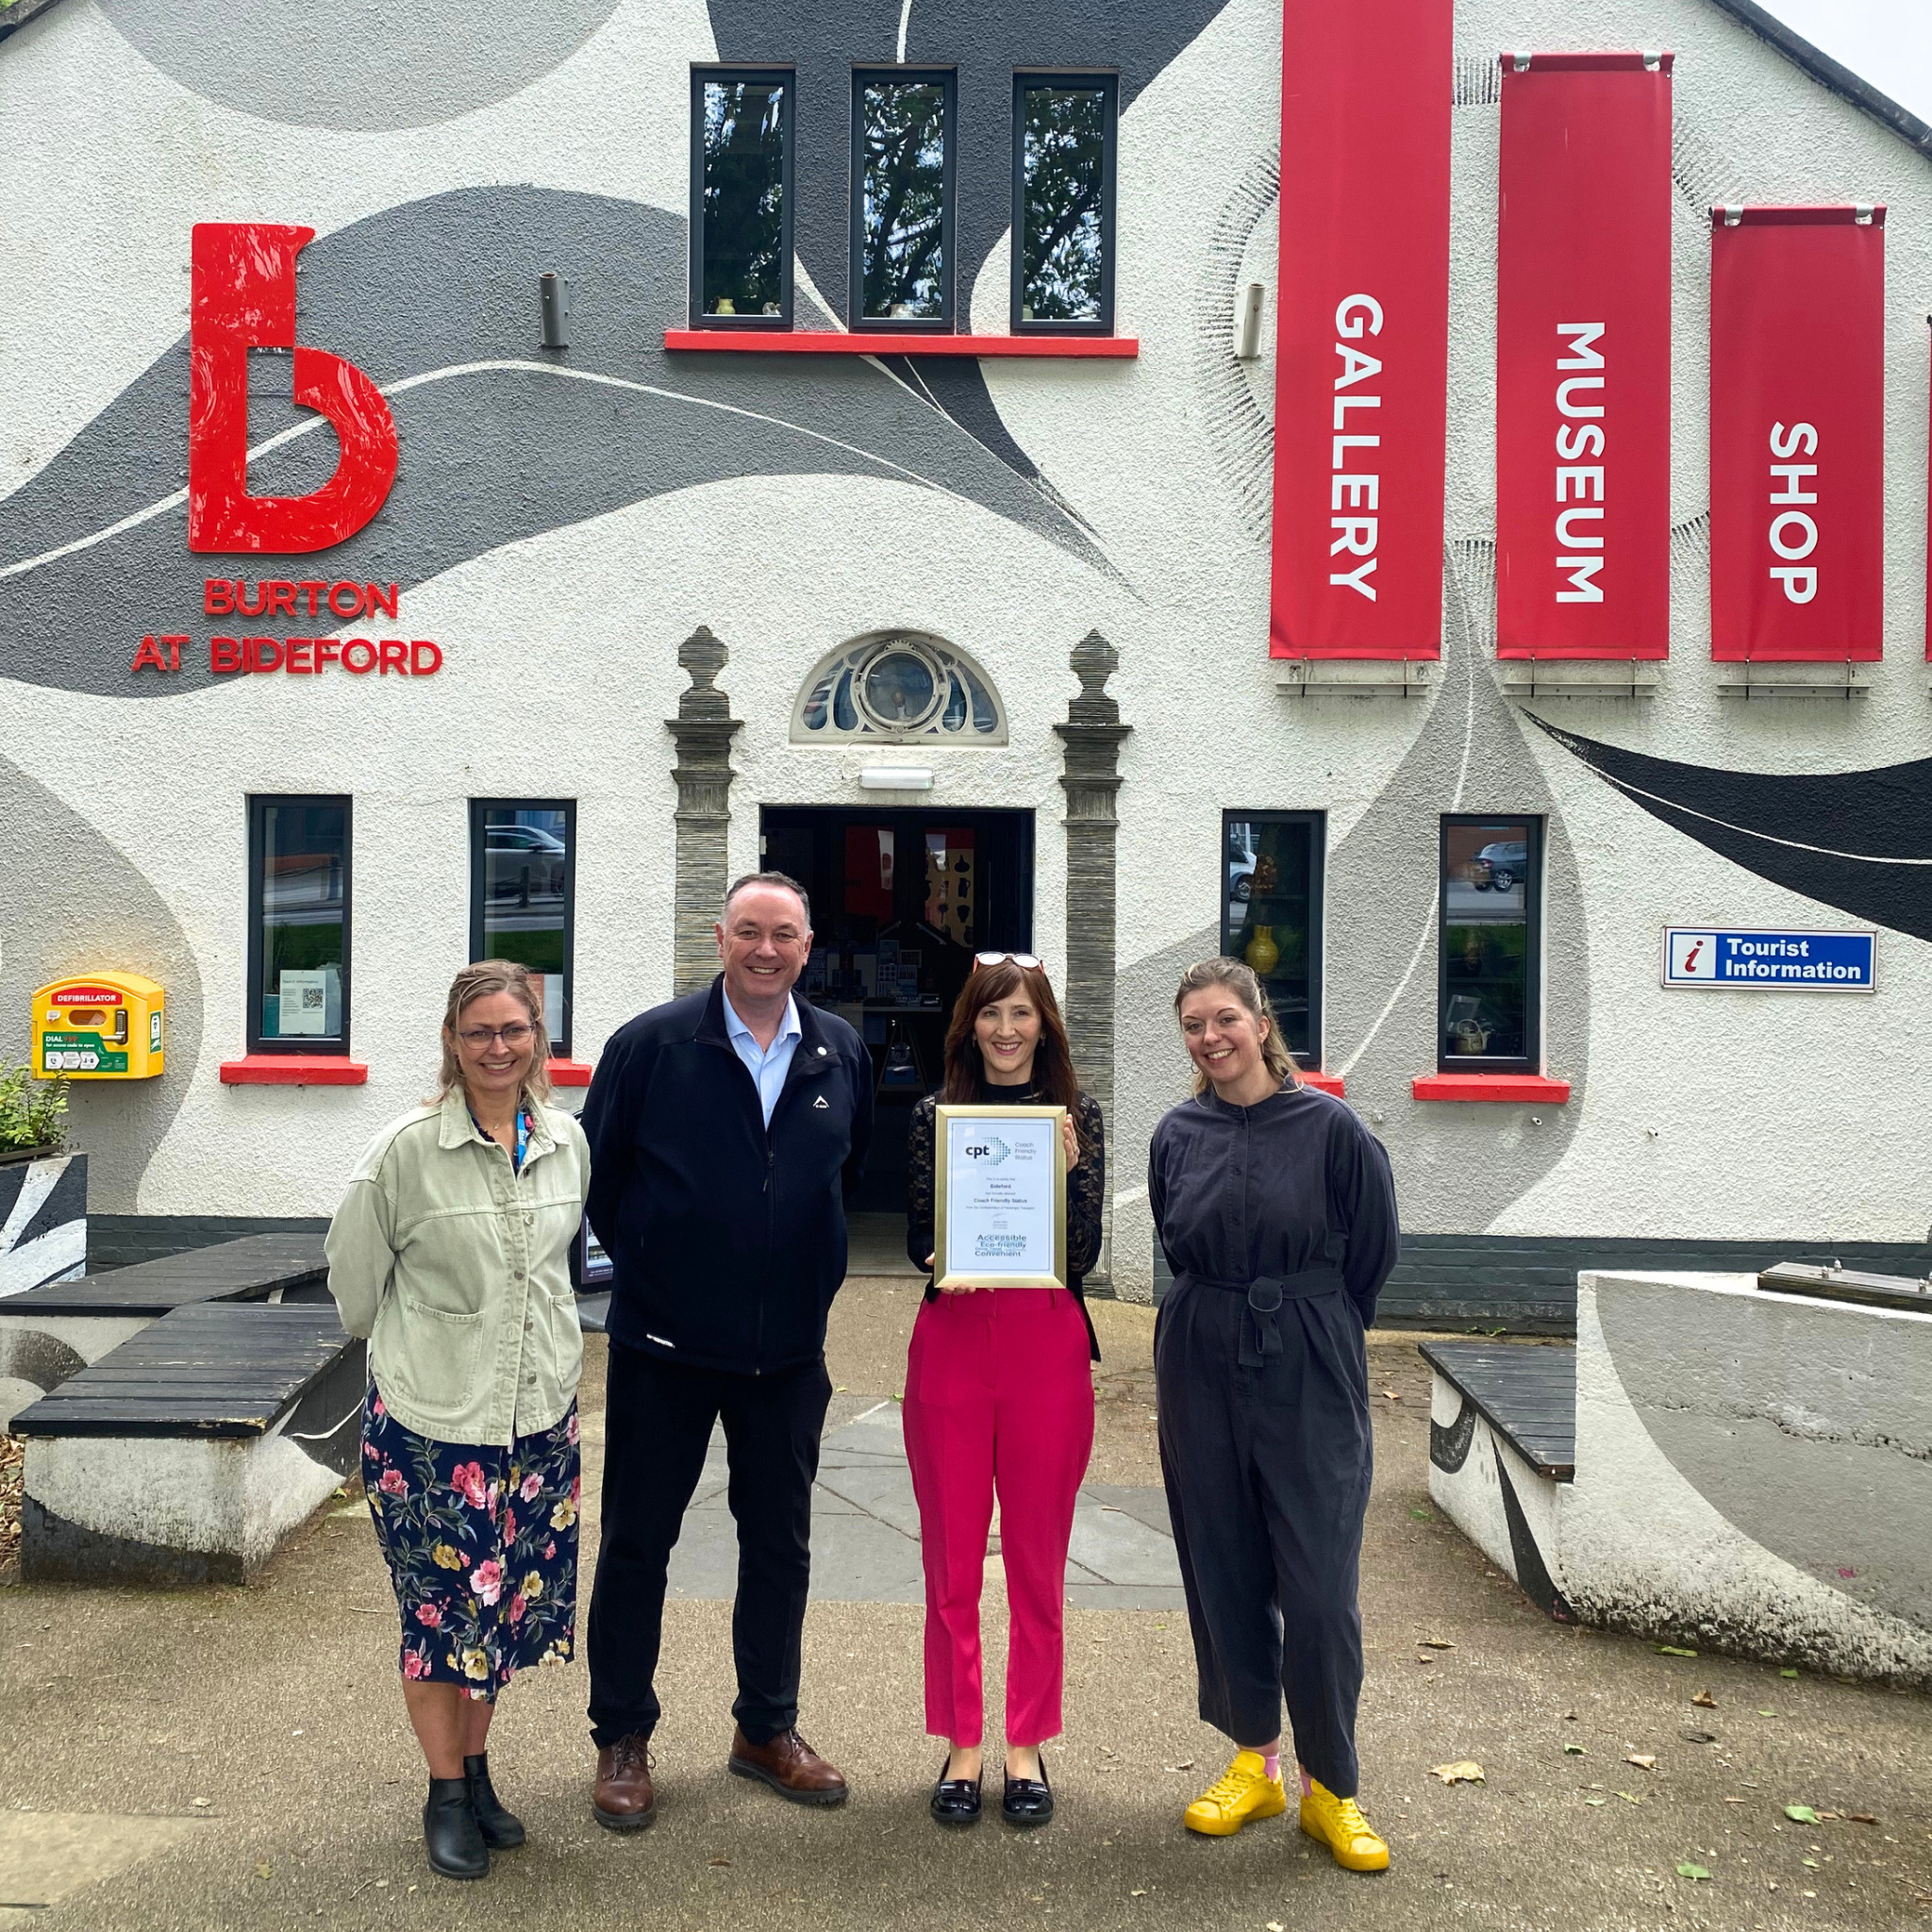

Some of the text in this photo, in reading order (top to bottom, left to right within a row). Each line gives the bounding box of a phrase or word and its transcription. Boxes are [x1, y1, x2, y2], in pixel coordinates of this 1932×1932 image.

[1329, 292, 1384, 602] GALLERY
[1556, 322, 1606, 604] MUSEUM
[1769, 421, 1818, 605] SHOP
[204, 577, 399, 619] BURTON
[131, 634, 443, 675] AT BIDEFORD
[1726, 938, 1809, 957] Tourist
[1725, 958, 1861, 980] Information
[965, 1145, 990, 1158] cpt
